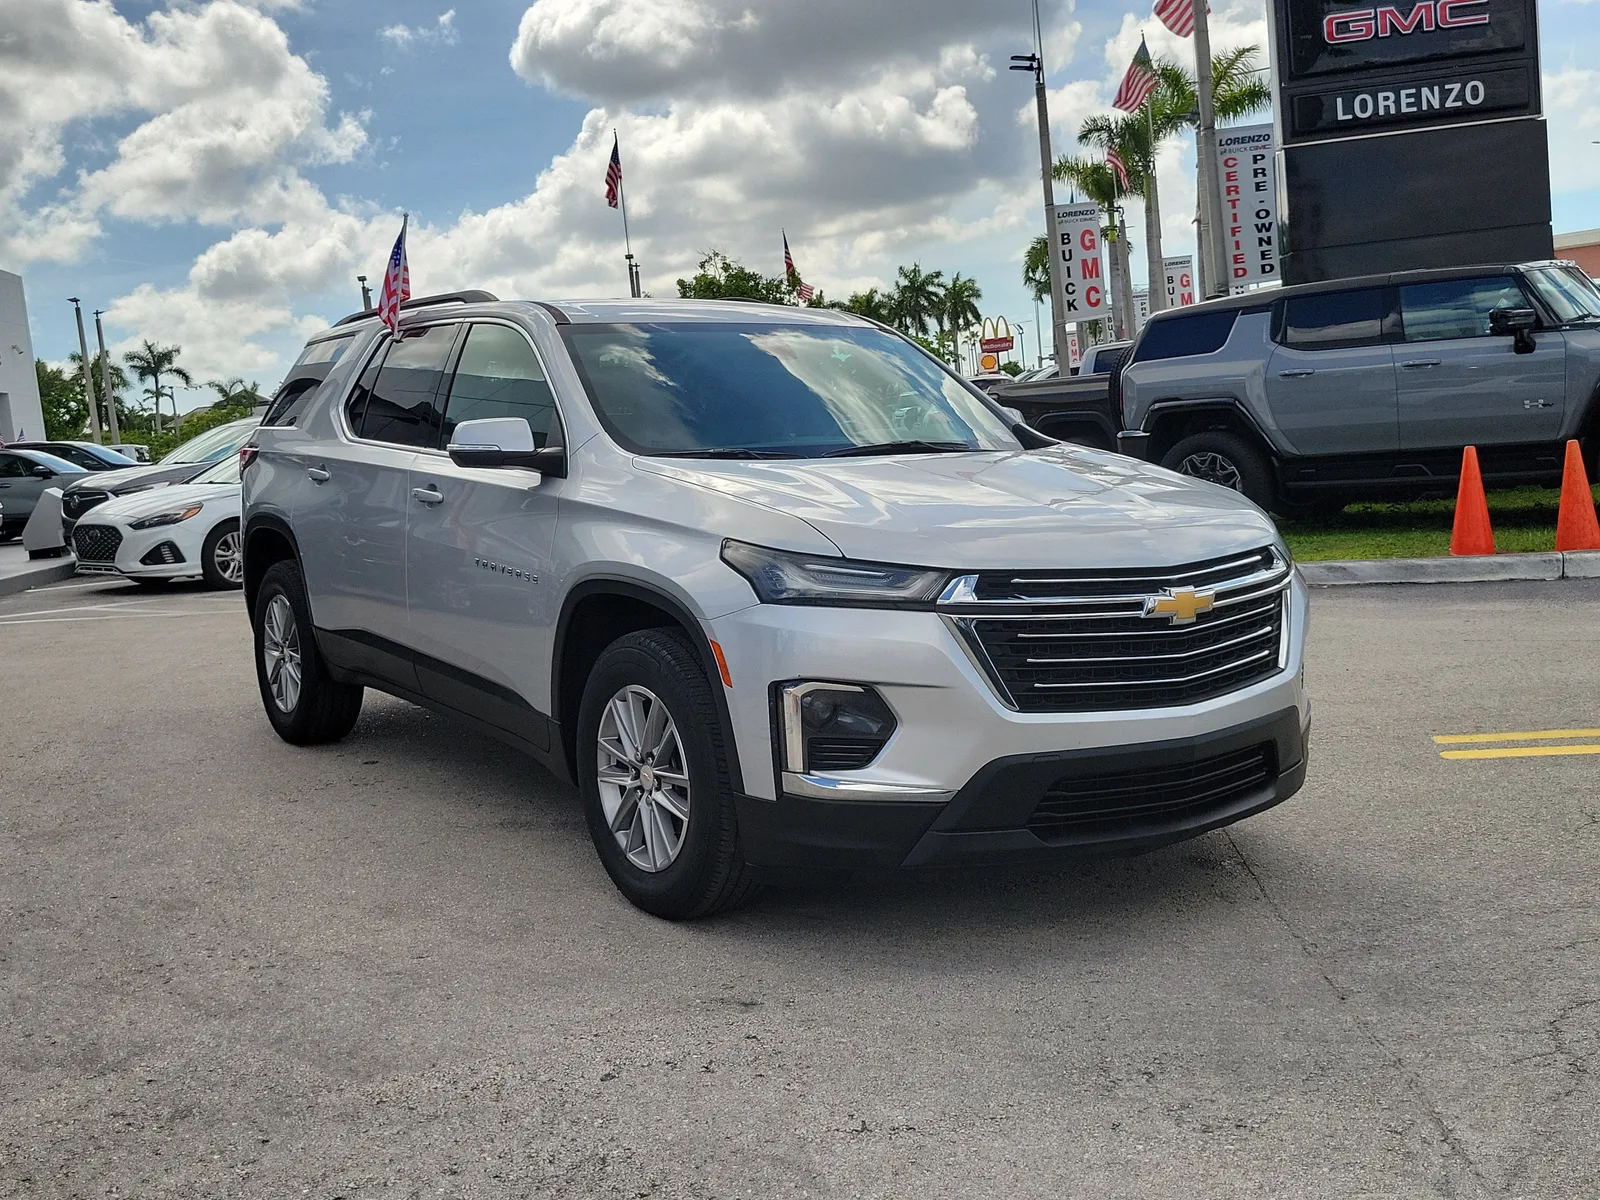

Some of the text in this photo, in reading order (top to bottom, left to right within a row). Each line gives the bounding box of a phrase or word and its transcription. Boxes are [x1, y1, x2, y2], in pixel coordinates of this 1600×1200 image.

[1323, 0, 1489, 44] GMC
[1336, 80, 1485, 121] LORENZO
[1218, 133, 1271, 147] LORENZO
[1228, 146, 1248, 154] BUICK
[1057, 209, 1096, 218] LORENZO
[1223, 157, 1248, 278] CERTIFIED
[1252, 154, 1275, 274] PRE-OWNED
[1060, 232, 1079, 312] BUICK
[1080, 229, 1101, 308] GMC
[982, 342, 1012, 350] McDonald's
[474, 556, 539, 585] TRAVERSE
